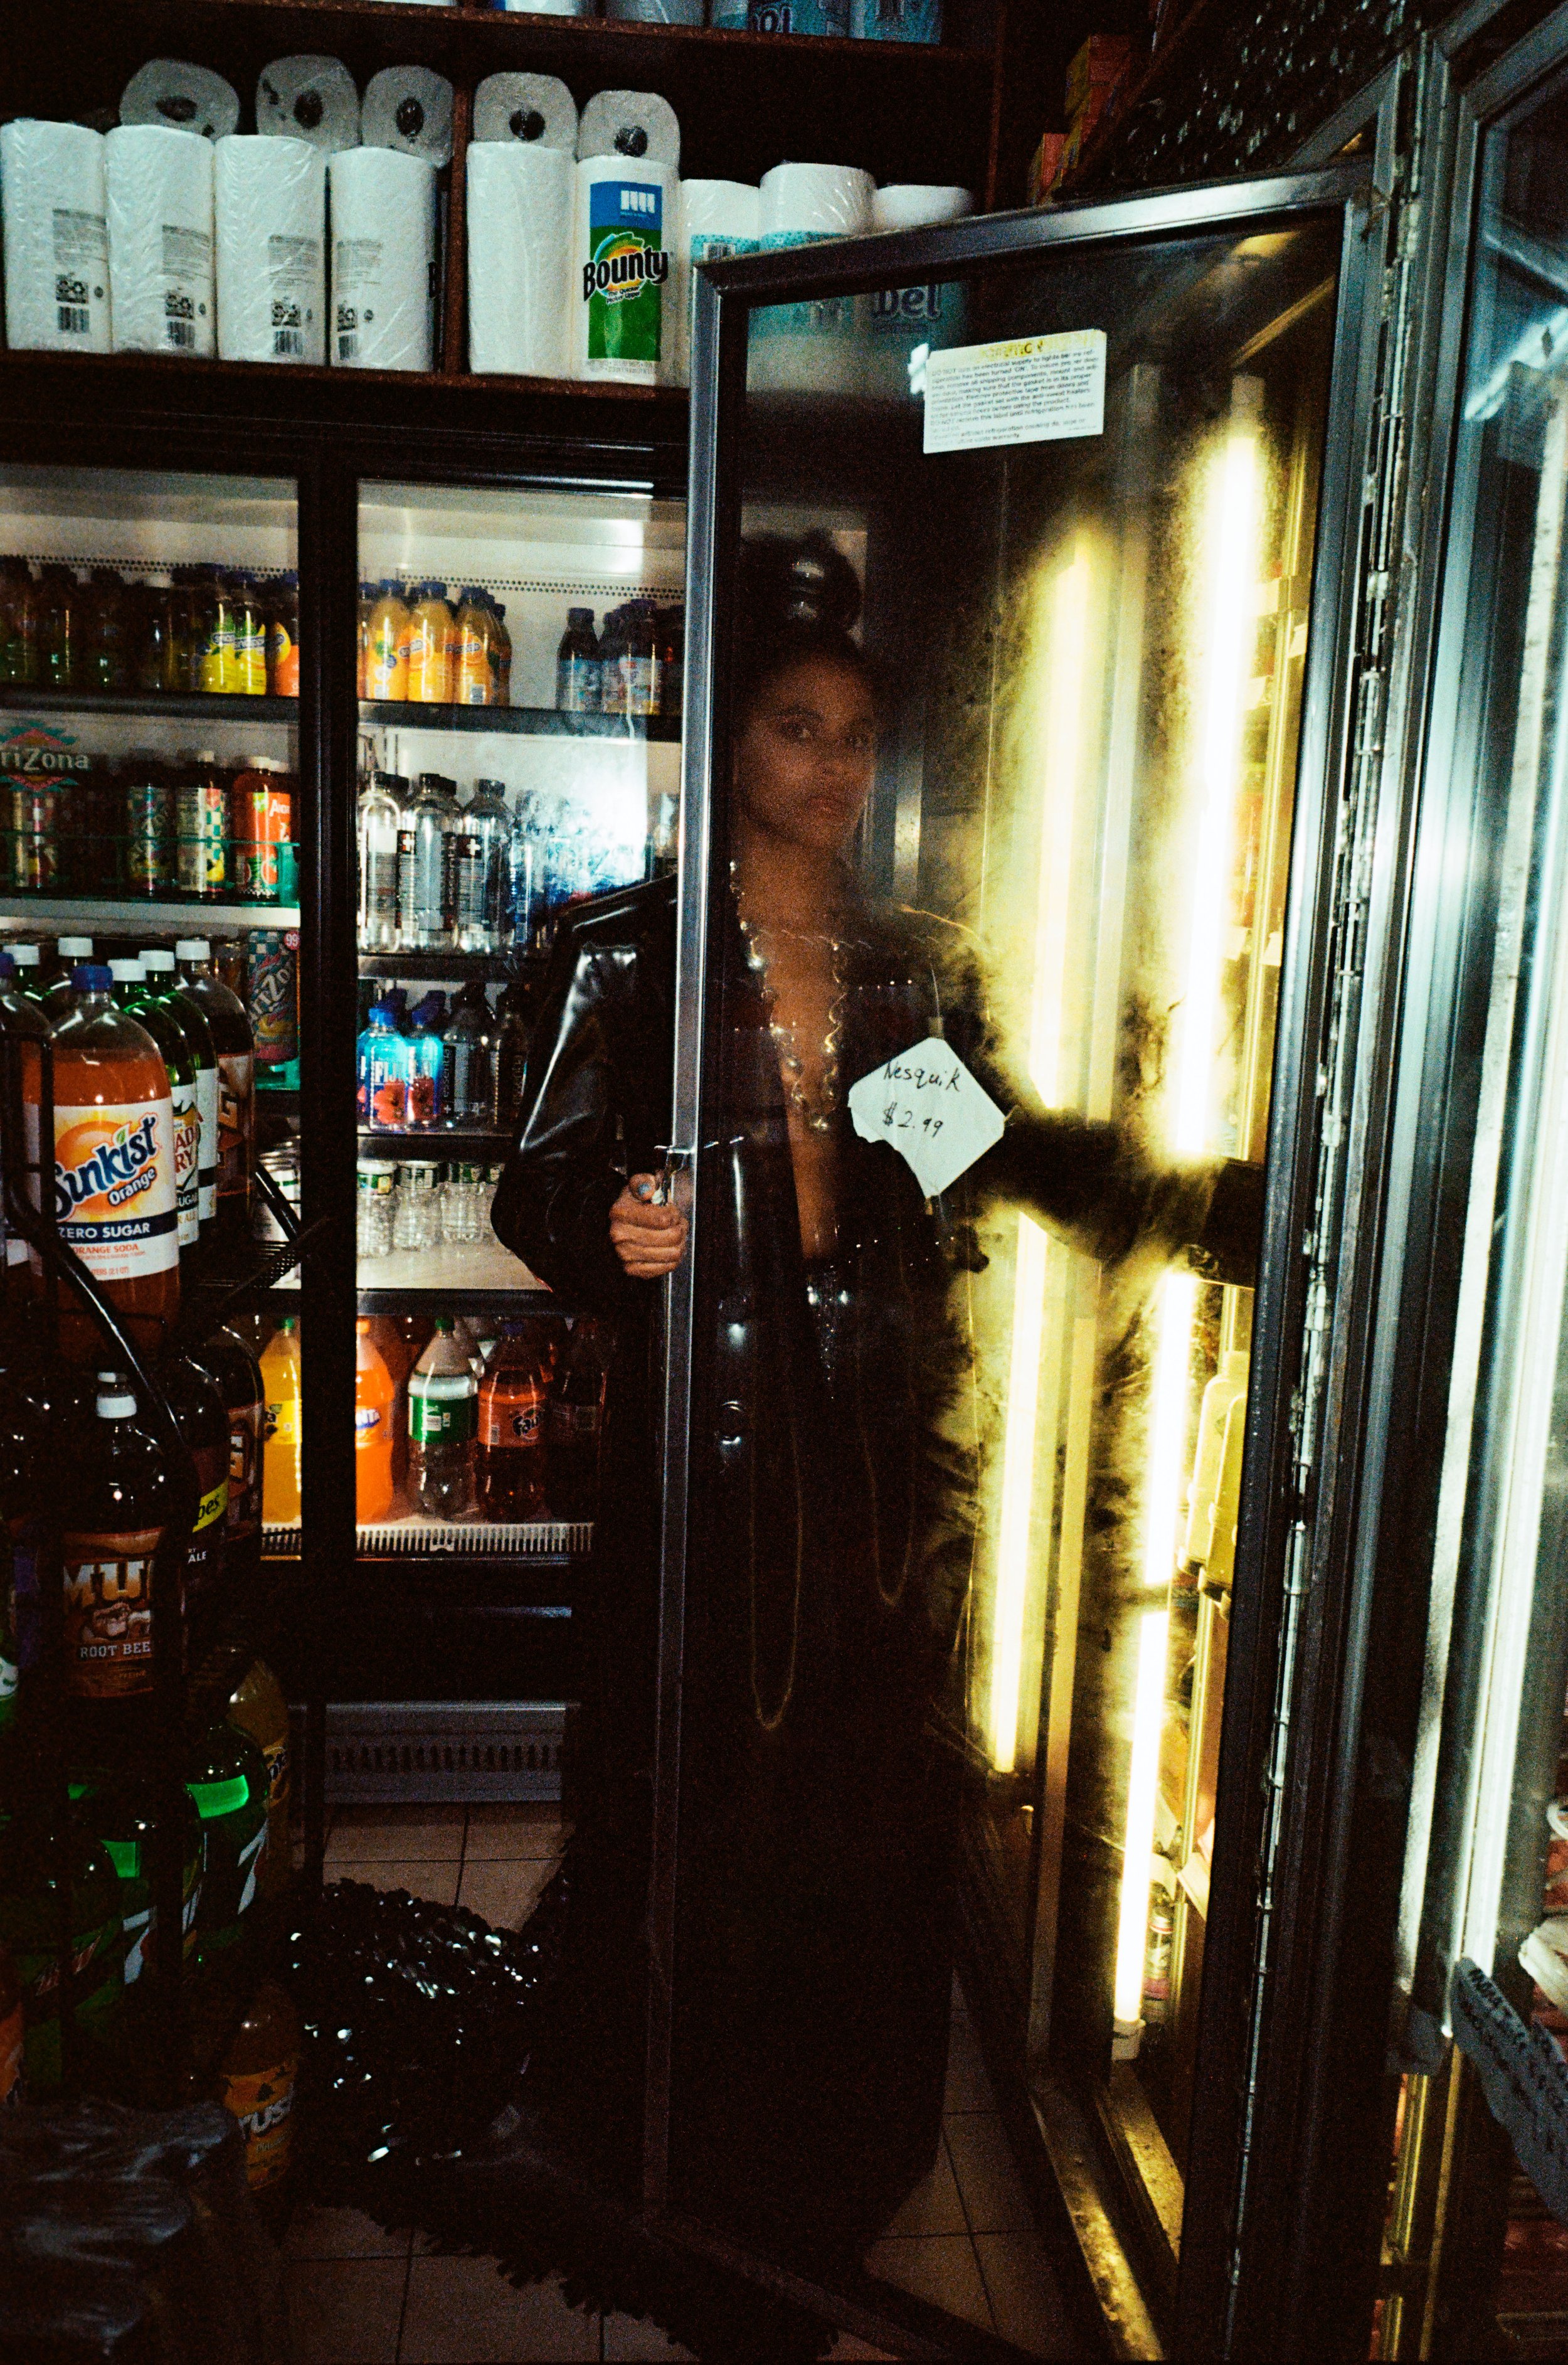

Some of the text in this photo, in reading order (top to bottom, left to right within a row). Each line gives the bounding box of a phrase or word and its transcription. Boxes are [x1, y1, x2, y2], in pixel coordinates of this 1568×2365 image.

[583, 247, 669, 302] Bounty
[883, 1062, 960, 1093] Nesquik
[882, 1102, 944, 1138] $2.99
[109, 1168, 156, 1206] Orange
[102, 1223, 151, 1238] SUGAR
[114, 1243, 139, 1253] SODA
[61, 1556, 129, 1605] MU
[80, 1641, 151, 1658] ROOT BEE
